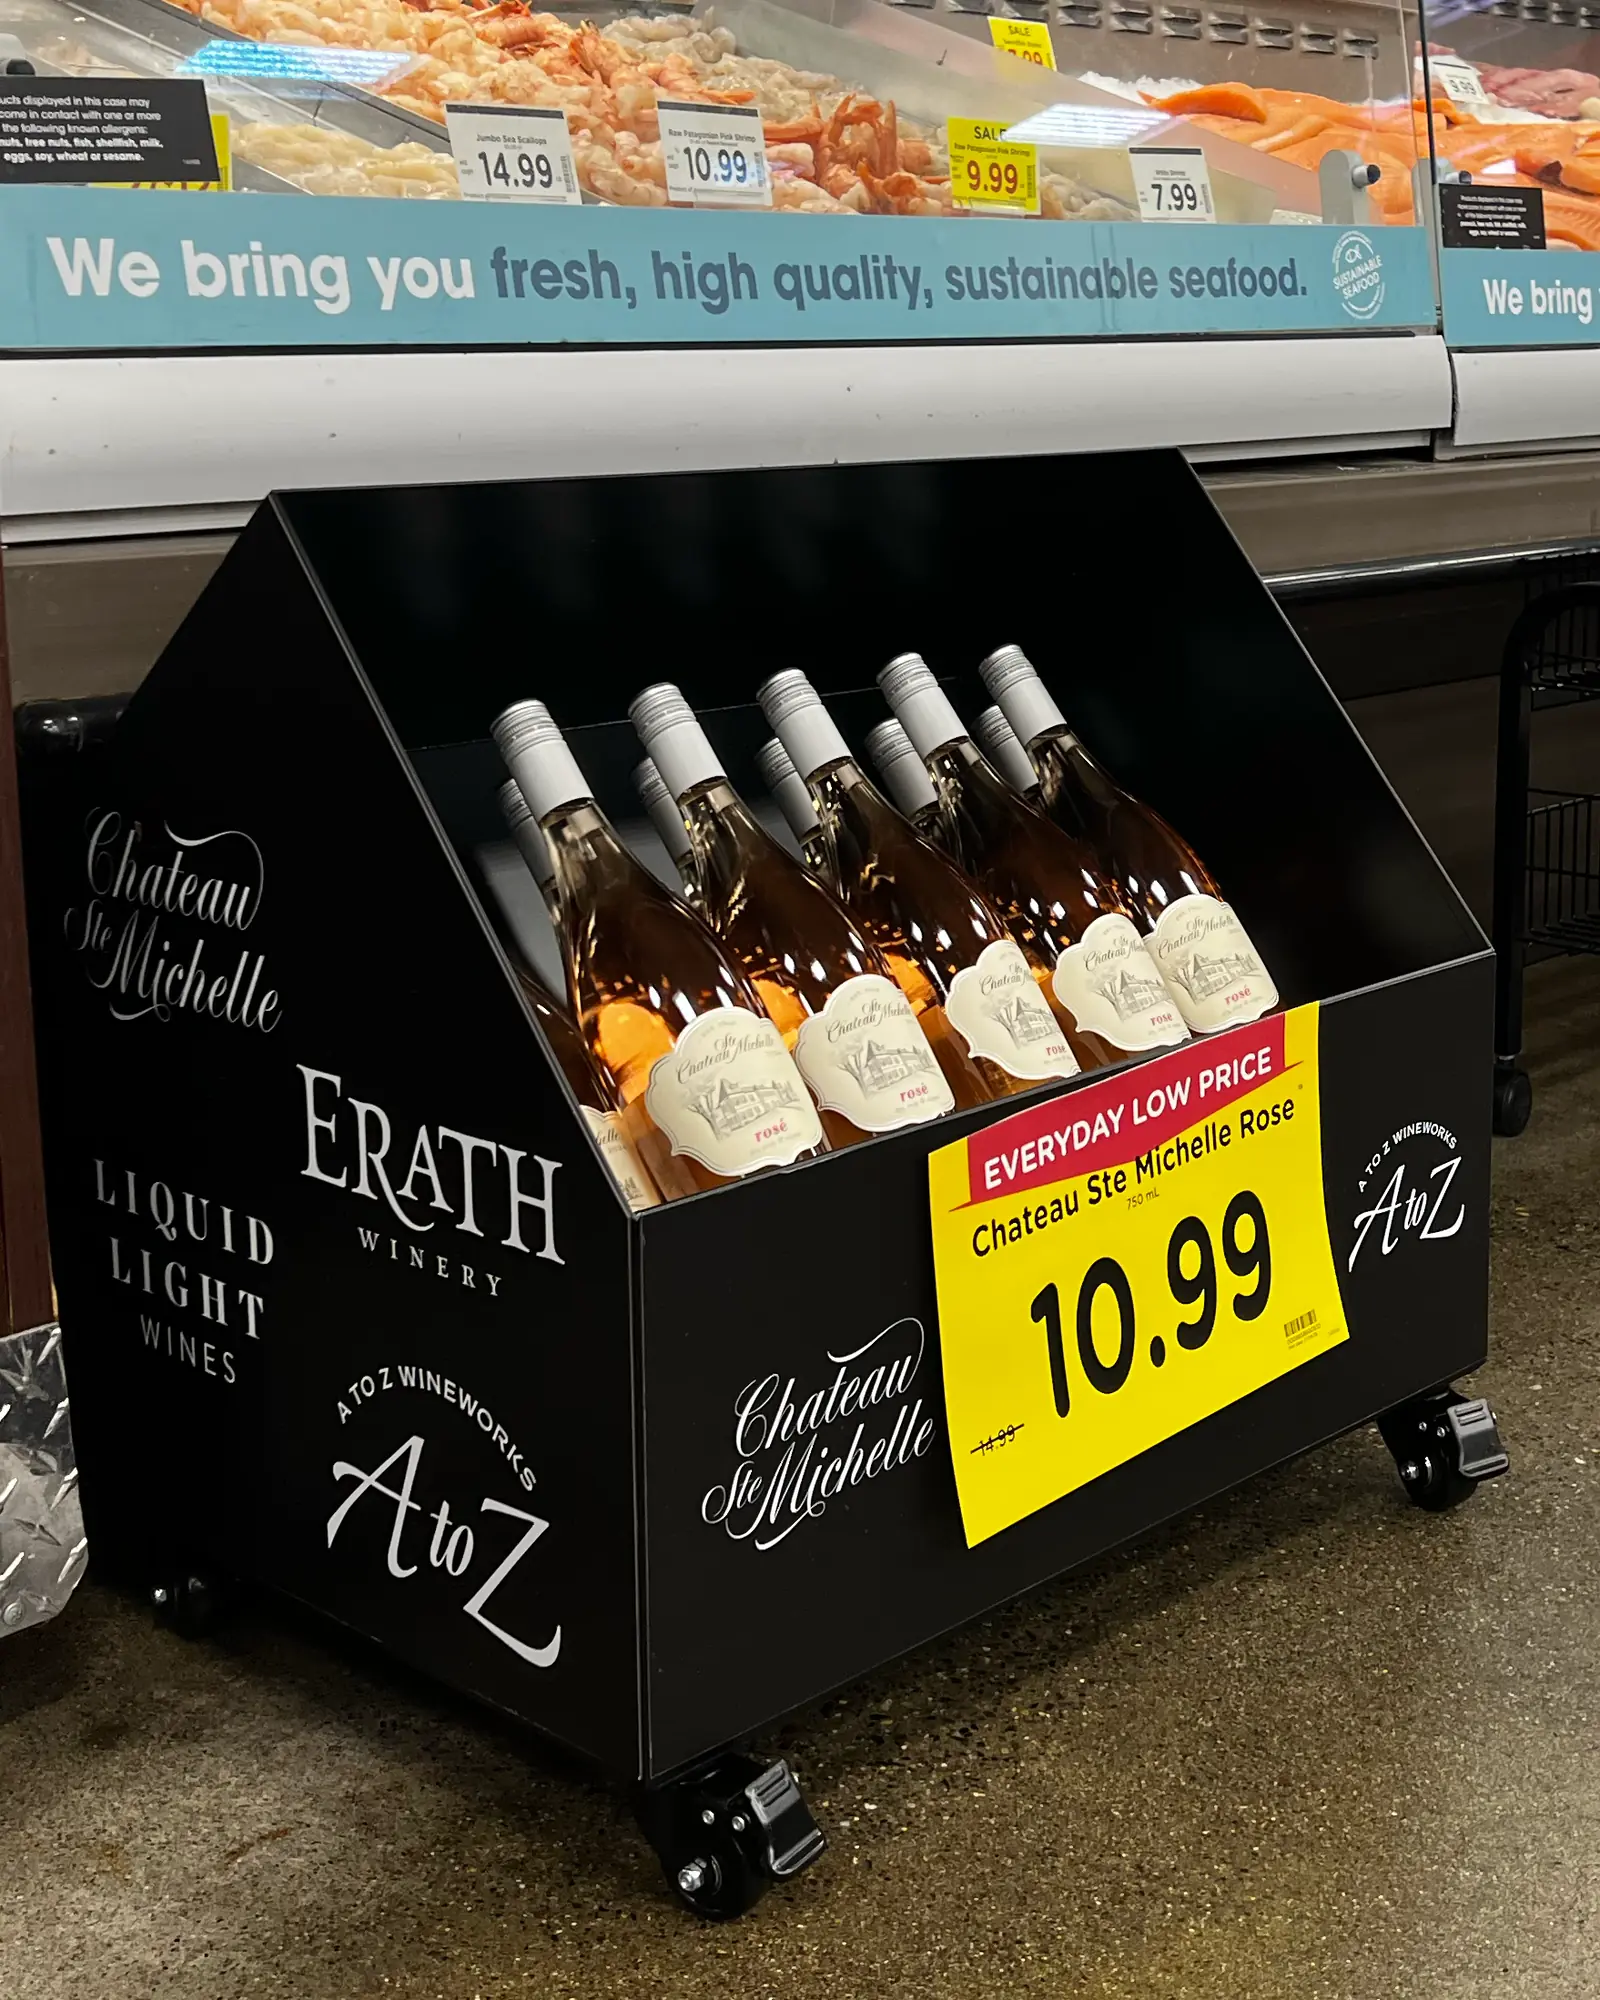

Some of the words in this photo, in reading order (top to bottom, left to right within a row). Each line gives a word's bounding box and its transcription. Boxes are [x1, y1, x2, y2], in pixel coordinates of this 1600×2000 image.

[1008, 25, 1031, 36] SALE
[23, 96, 71, 107] displayed
[72, 96, 83, 106] in
[84, 96, 101, 107] this
[103, 98, 127, 107] case
[129, 98, 150, 109] may
[29, 110, 39, 119] in
[41, 110, 80, 120] contact
[82, 110, 102, 120] with
[103, 112, 123, 120] one
[124, 112, 135, 121] or
[136, 112, 161, 121] more
[2, 123, 20, 133] the
[21, 123, 66, 136] following
[67, 124, 100, 134] known
[25, 138, 46, 147] tree
[476, 134, 501, 143] Jumbo
[502, 135, 516, 144] Sea
[517, 136, 547, 146] Scallops
[668, 128, 682, 137] Raw
[683, 130, 719, 139] Patagonian
[720, 132, 733, 140] Pink
[734, 134, 756, 143] Shrimp
[1010, 148, 1031, 157] Shrimp
[56, 152, 88, 161] wheat
[90, 153, 101, 161] or
[102, 152, 145, 161] sesame.
[478, 152, 552, 188] 14.99
[683, 146, 748, 183] 10.99
[967, 160, 1018, 194] 9.99
[1151, 183, 1197, 211] 7.99
[46, 237, 160, 297] We
[180, 239, 350, 315] bring
[366, 256, 475, 310] you
[490, 246, 637, 309] fresh,
[650, 250, 759, 315] high
[773, 252, 933, 312] quality,
[945, 256, 1158, 301] sustainable
[1168, 256, 1307, 299] seafood.
[1332, 255, 1383, 290] SUSTAINABLE
[1342, 271, 1380, 300] SEAFOOD
[1482, 278, 1524, 315] We
[1530, 279, 1592, 324] bring
[84, 806, 264, 931] Chateau
[64, 899, 112, 953] Ste
[85, 909, 283, 1033] Michelle
[1224, 984, 1252, 1005] rosé
[900, 1082, 929, 1102] rosé
[754, 1117, 789, 1143] rosé
[984, 1103, 1125, 1190] EVERYDAY
[1132, 1077, 1192, 1125] LOW
[1199, 1046, 1272, 1098] PRICE
[296, 1063, 566, 1265] ERATH
[972, 1188, 1079, 1257] Chateau
[1087, 1169, 1127, 1205] Ste
[1135, 1121, 1231, 1185] Michelle
[1240, 1098, 1295, 1140] Rose
[1358, 1180, 1367, 1193] A
[1365, 1153, 1381, 1175] TO
[1382, 1141, 1391, 1156] Z
[1392, 1121, 1458, 1150] WINEWORKS
[93, 1158, 274, 1264] LIQUID
[1126, 1193, 1144, 1211] 750
[1146, 1187, 1160, 1202] mL
[1349, 1164, 1406, 1273] A
[1404, 1188, 1428, 1230] to
[1419, 1156, 1466, 1240] Z
[357, 1226, 502, 1296] WINERY
[110, 1236, 264, 1340] LIGHT
[1030, 1190, 1272, 1418] 10.99
[140, 1313, 236, 1384] WINES
[734, 1317, 925, 1458] Chateau
[337, 1400, 352, 1424] A
[348, 1375, 375, 1405] TO
[378, 1367, 393, 1390] Z
[397, 1365, 537, 1491] WINEWORKS
[701, 1460, 764, 1524] Ste
[725, 1399, 937, 1550] Michelle
[327, 1435, 425, 1578] A
[430, 1500, 474, 1576] to
[462, 1497, 561, 1667] Z
